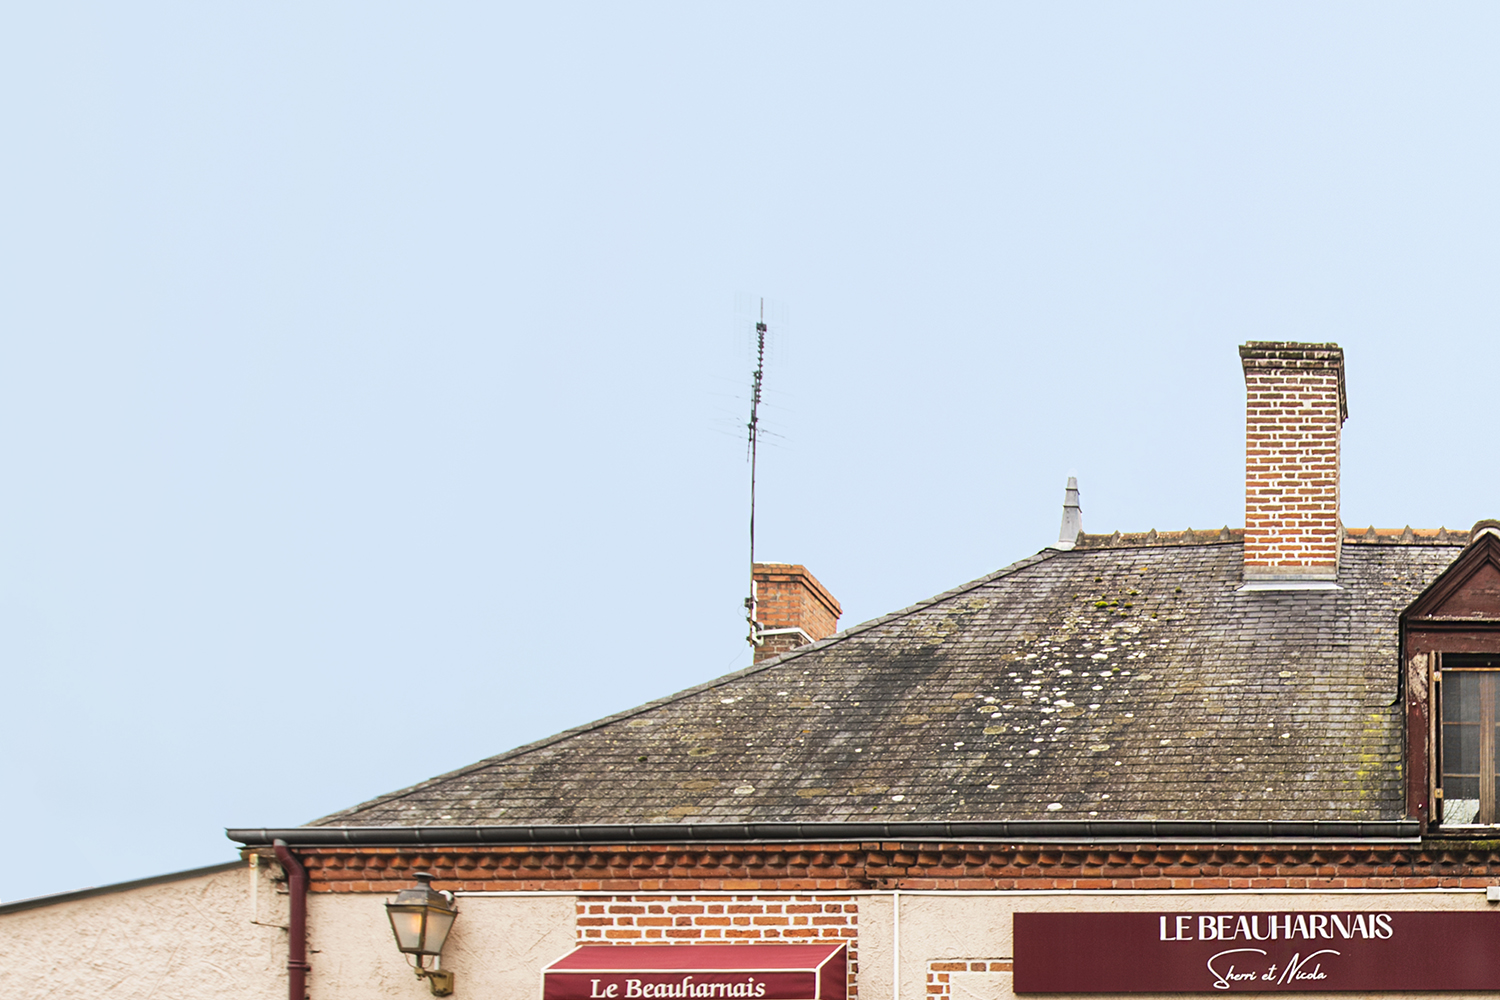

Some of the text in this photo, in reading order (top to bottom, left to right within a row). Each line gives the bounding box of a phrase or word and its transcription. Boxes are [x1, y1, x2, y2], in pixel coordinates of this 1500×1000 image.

[1160, 913, 1393, 941] LE BEAUHARNAIS
[1207, 948, 1341, 990] Sherri et Nicola
[590, 976, 766, 999] Le Beauharnais
